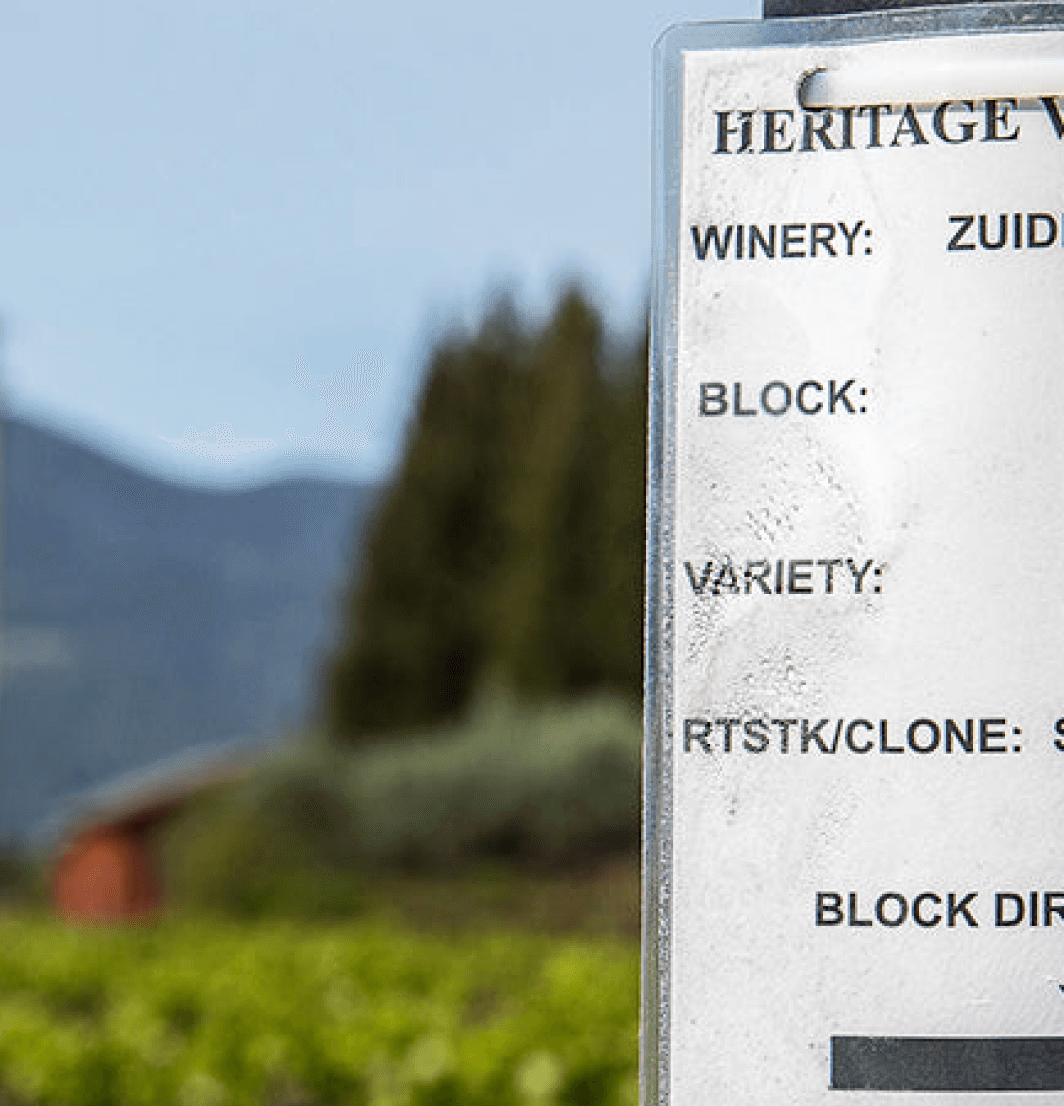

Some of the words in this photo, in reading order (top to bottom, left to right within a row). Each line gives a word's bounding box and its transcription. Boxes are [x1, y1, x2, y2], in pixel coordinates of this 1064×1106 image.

[712, 97, 1020, 155] HERITAGE
[690, 220, 873, 261] WINERY:
[699, 380, 868, 417] BLOCK:
[684, 558, 885, 597] VARIETY:
[683, 717, 1023, 755] RTSTK/CLONE:
[815, 891, 979, 929] BLOCK
